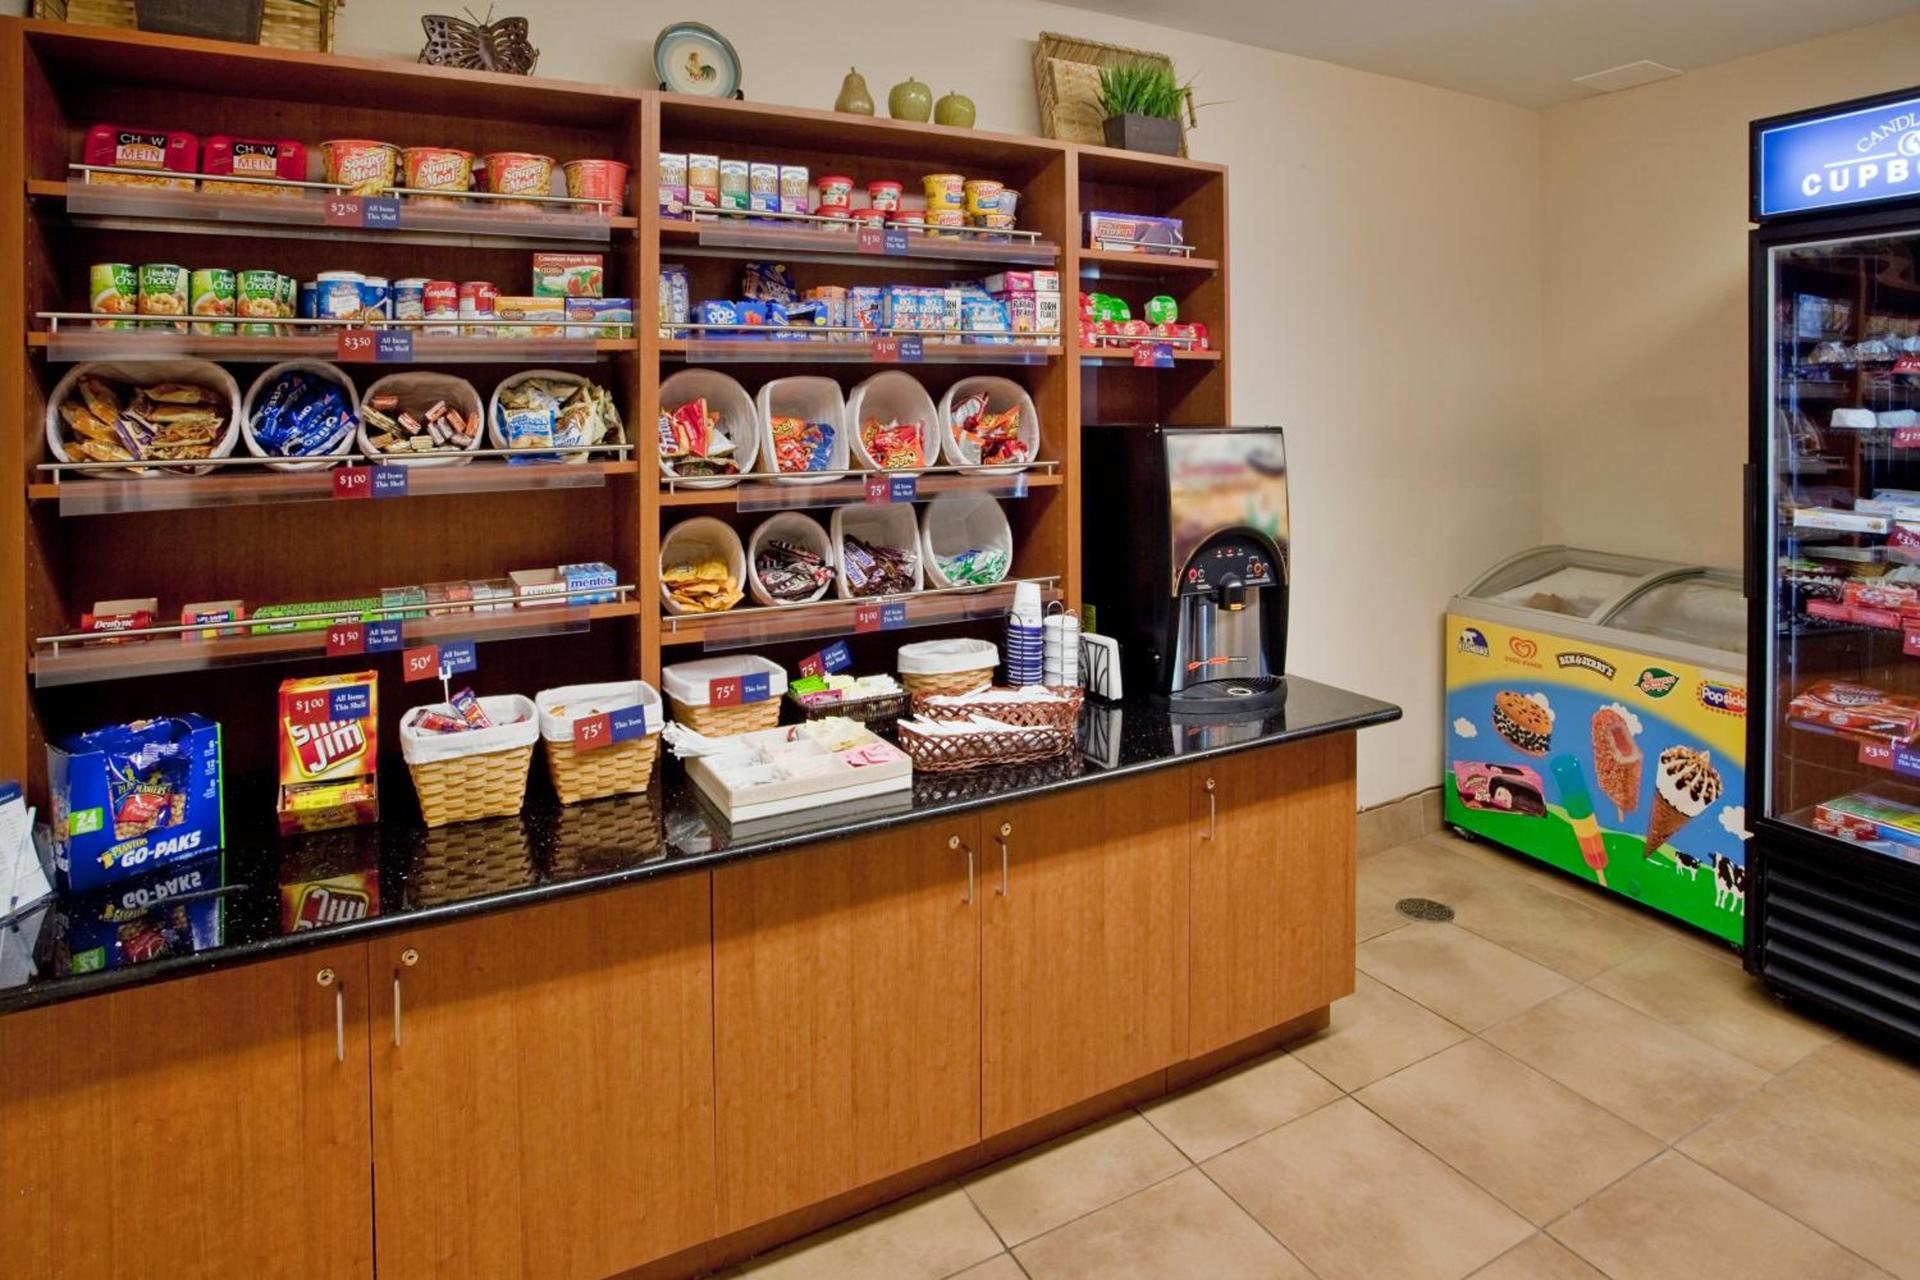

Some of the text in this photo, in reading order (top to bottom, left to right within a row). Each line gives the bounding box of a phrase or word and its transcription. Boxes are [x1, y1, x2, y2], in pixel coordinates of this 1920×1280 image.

[121, 133, 165, 146] CHW
[122, 148, 159, 161] MEIN
[235, 144, 275, 156] CHW
[238, 158, 273, 170] MEIN
[343, 152, 387, 172] Souper
[420, 157, 462, 177] Souper
[349, 166, 382, 182] Meal
[427, 171, 456, 187] Meal
[503, 164, 544, 182] Souper
[1802, 159, 1920, 196] CUPB
[509, 175, 538, 189] Meal
[148, 267, 179, 278] Healthy
[144, 275, 176, 286] Choice
[1040, 302, 1057, 310] CORN
[571, 575, 614, 588] mentos
[94, 618, 134, 630] Dentyne
[716, 684, 734, 700] 75¢
[744, 683, 768, 694] This Item
[336, 693, 365, 702] All Items
[335, 701, 367, 711] This Shelf
[615, 717, 641, 729] This Item
[582, 722, 603, 741] 75¢
[77, 811, 97, 827] 24
[110, 838, 148, 858] PLANTERS
[121, 830, 201, 867] GO-PAKS
